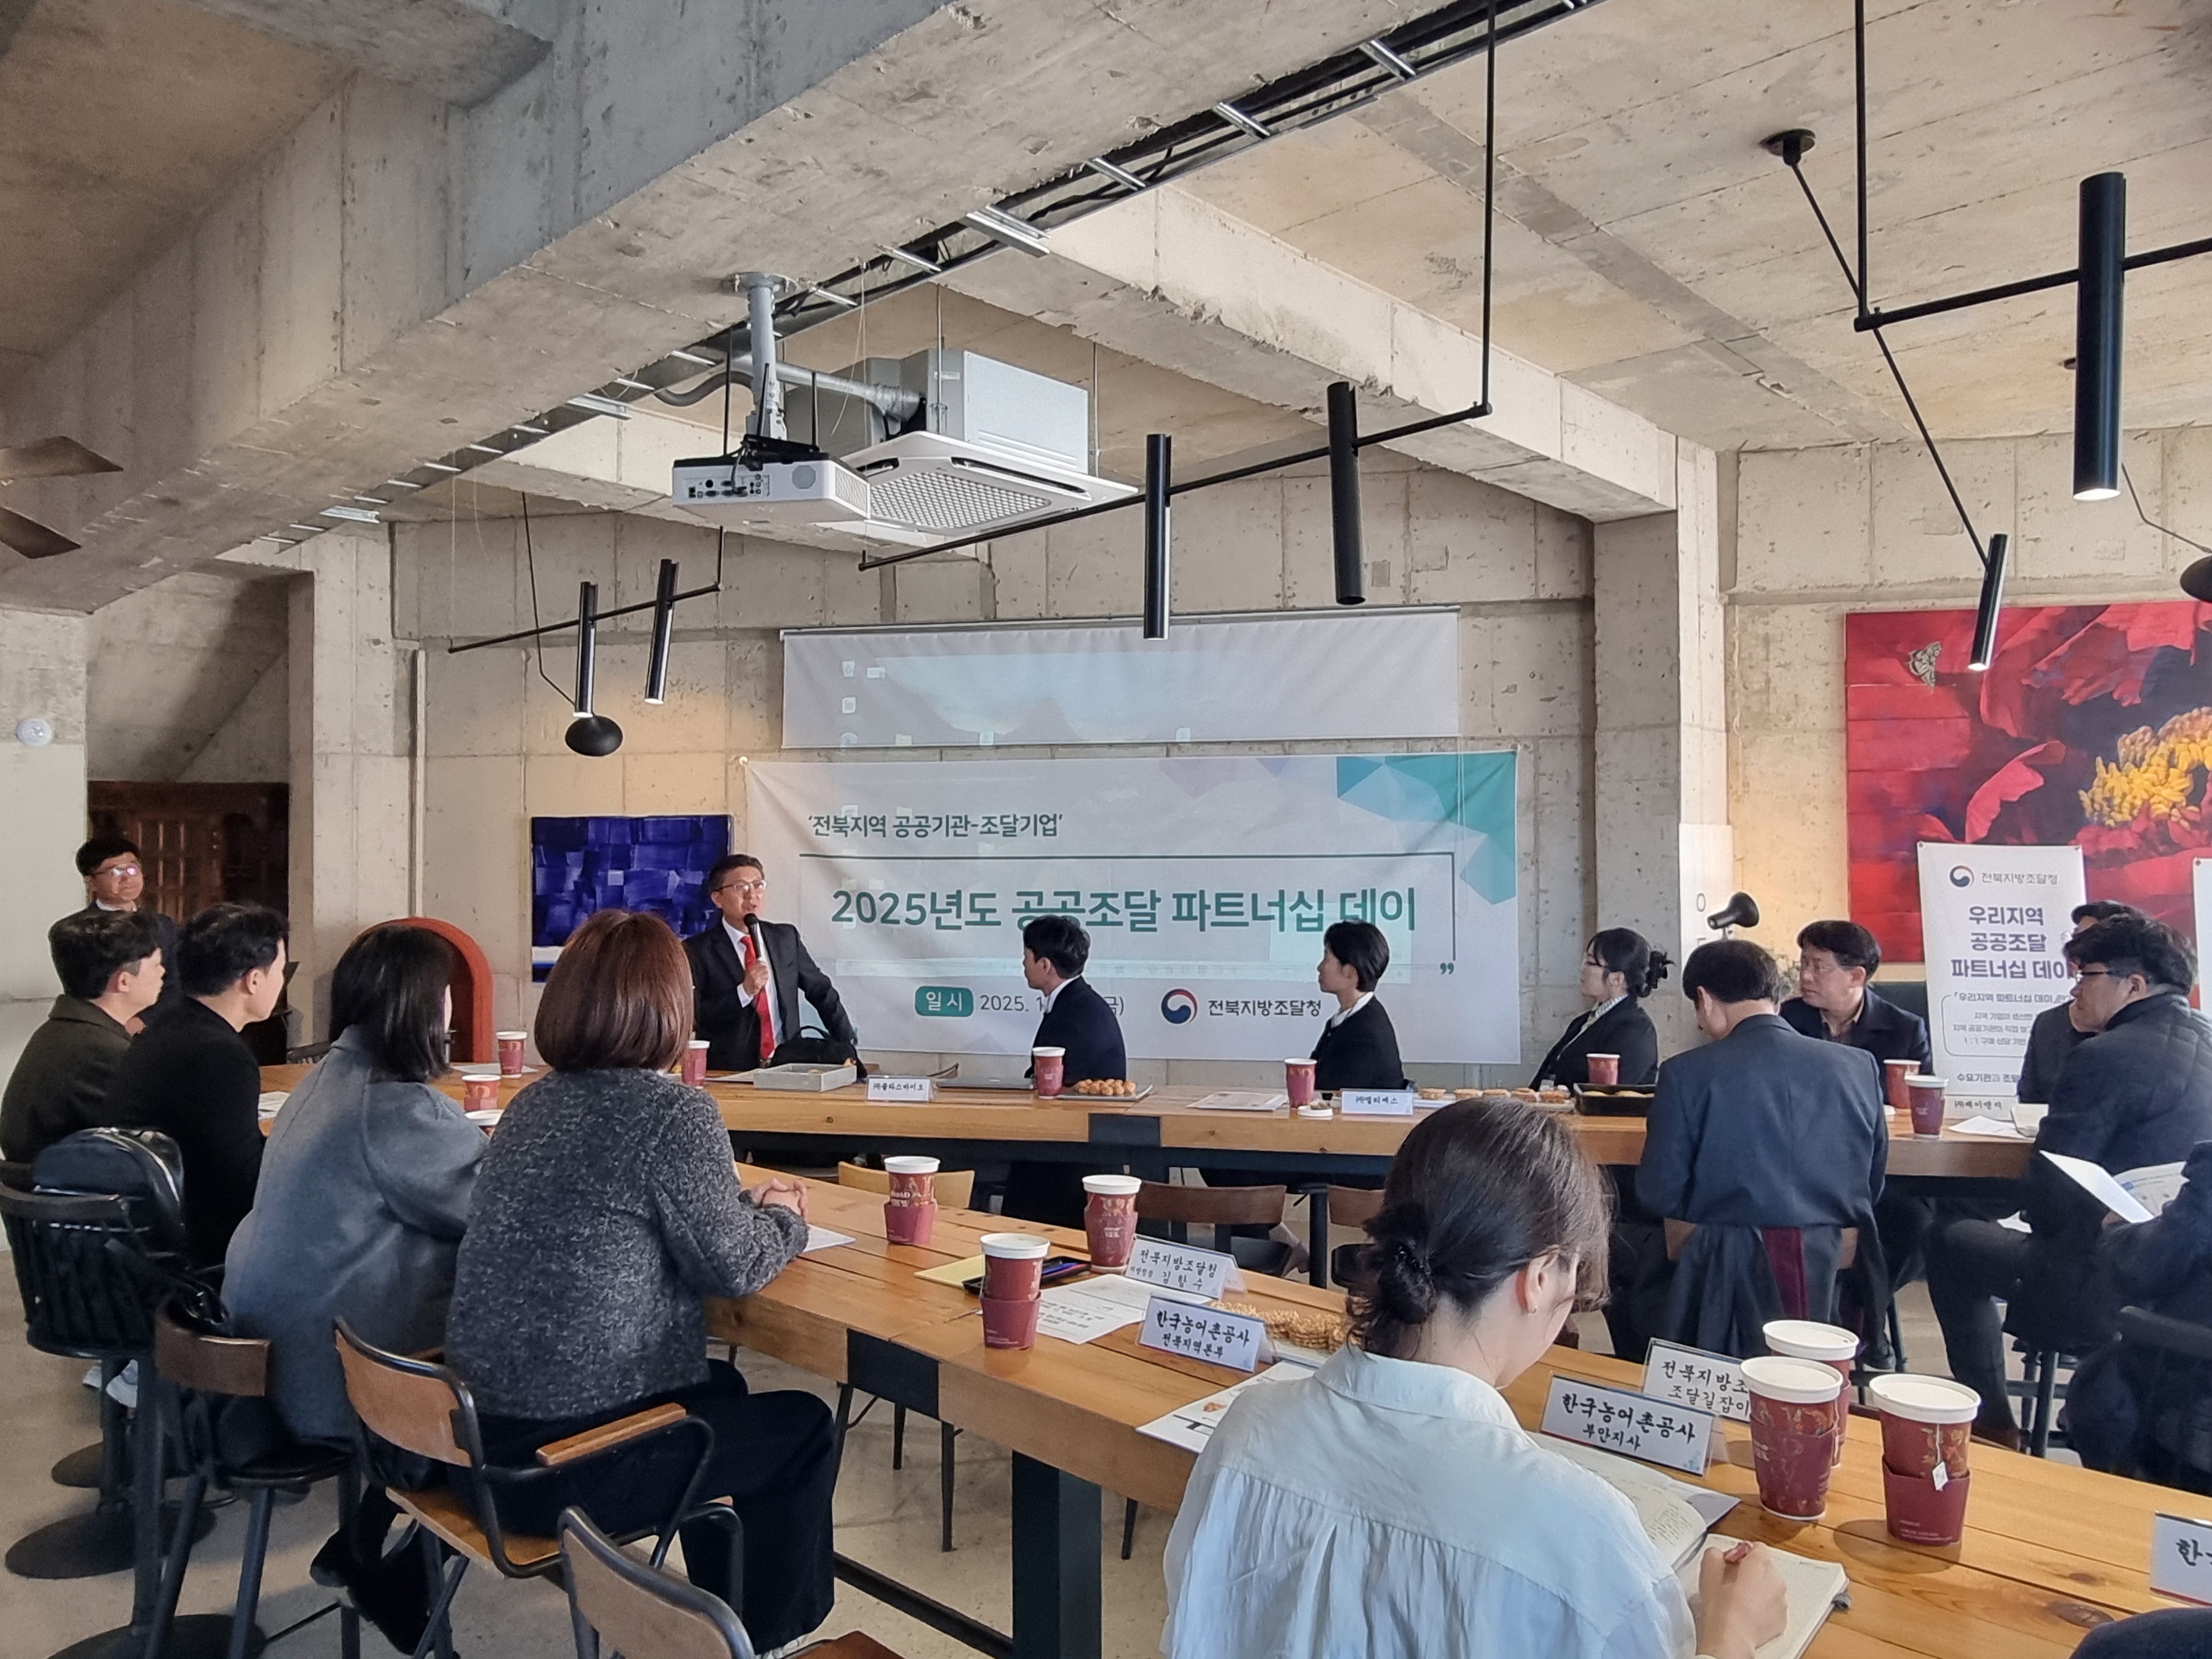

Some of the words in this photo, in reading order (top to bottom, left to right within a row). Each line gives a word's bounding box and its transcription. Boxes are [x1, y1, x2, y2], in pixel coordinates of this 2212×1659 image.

[831, 889, 1002, 931] 2025년도
[1012, 889, 1162, 932] 공공조달
[1172, 888, 1324, 933] 파트너십
[1340, 887, 1415, 931] 데이
[1969, 906, 2044, 926] 우리지역
[1970, 932, 2047, 952] 공공조달
[1950, 959, 2027, 979] 파트너십
[1208, 999, 1321, 1017] 전북지방조달청
[1139, 1249, 1218, 1279] 전북지방조달청
[1156, 1310, 1250, 1347] 한국농어촌공사
[1162, 1333, 1224, 1359] 전북지역본부
[1561, 1392, 1696, 1445] 한국농어촌공사
[1582, 1423, 1642, 1452] 부안지사
